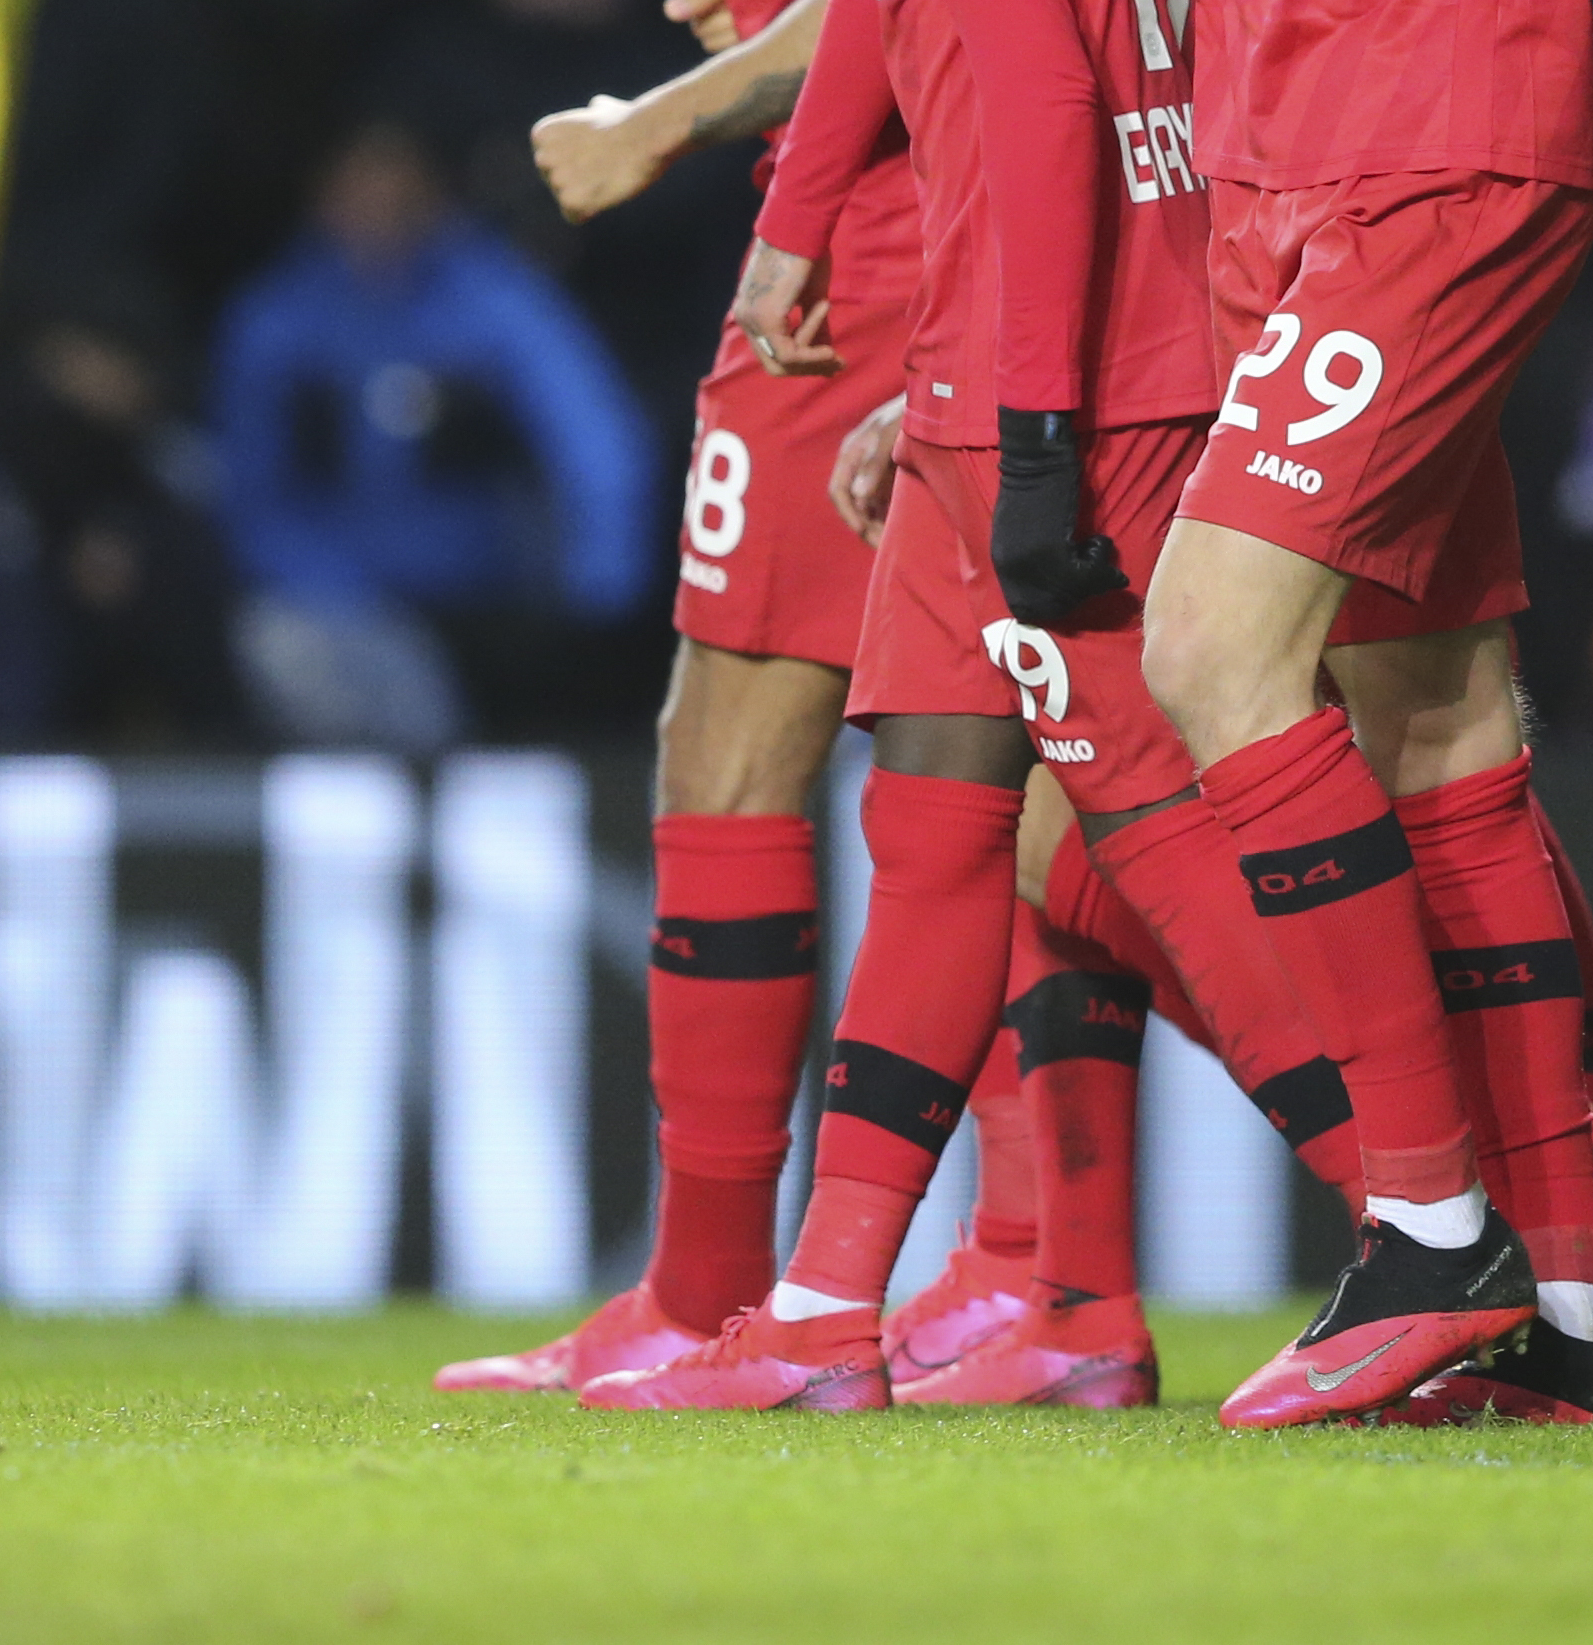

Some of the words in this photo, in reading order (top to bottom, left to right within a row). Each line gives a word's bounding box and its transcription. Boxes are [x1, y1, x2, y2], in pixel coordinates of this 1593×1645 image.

[1217, 312, 1385, 446] 29
[685, 417, 752, 557] 8
[1244, 450, 1324, 495] JAKO
[1257, 858, 1346, 895] 04
